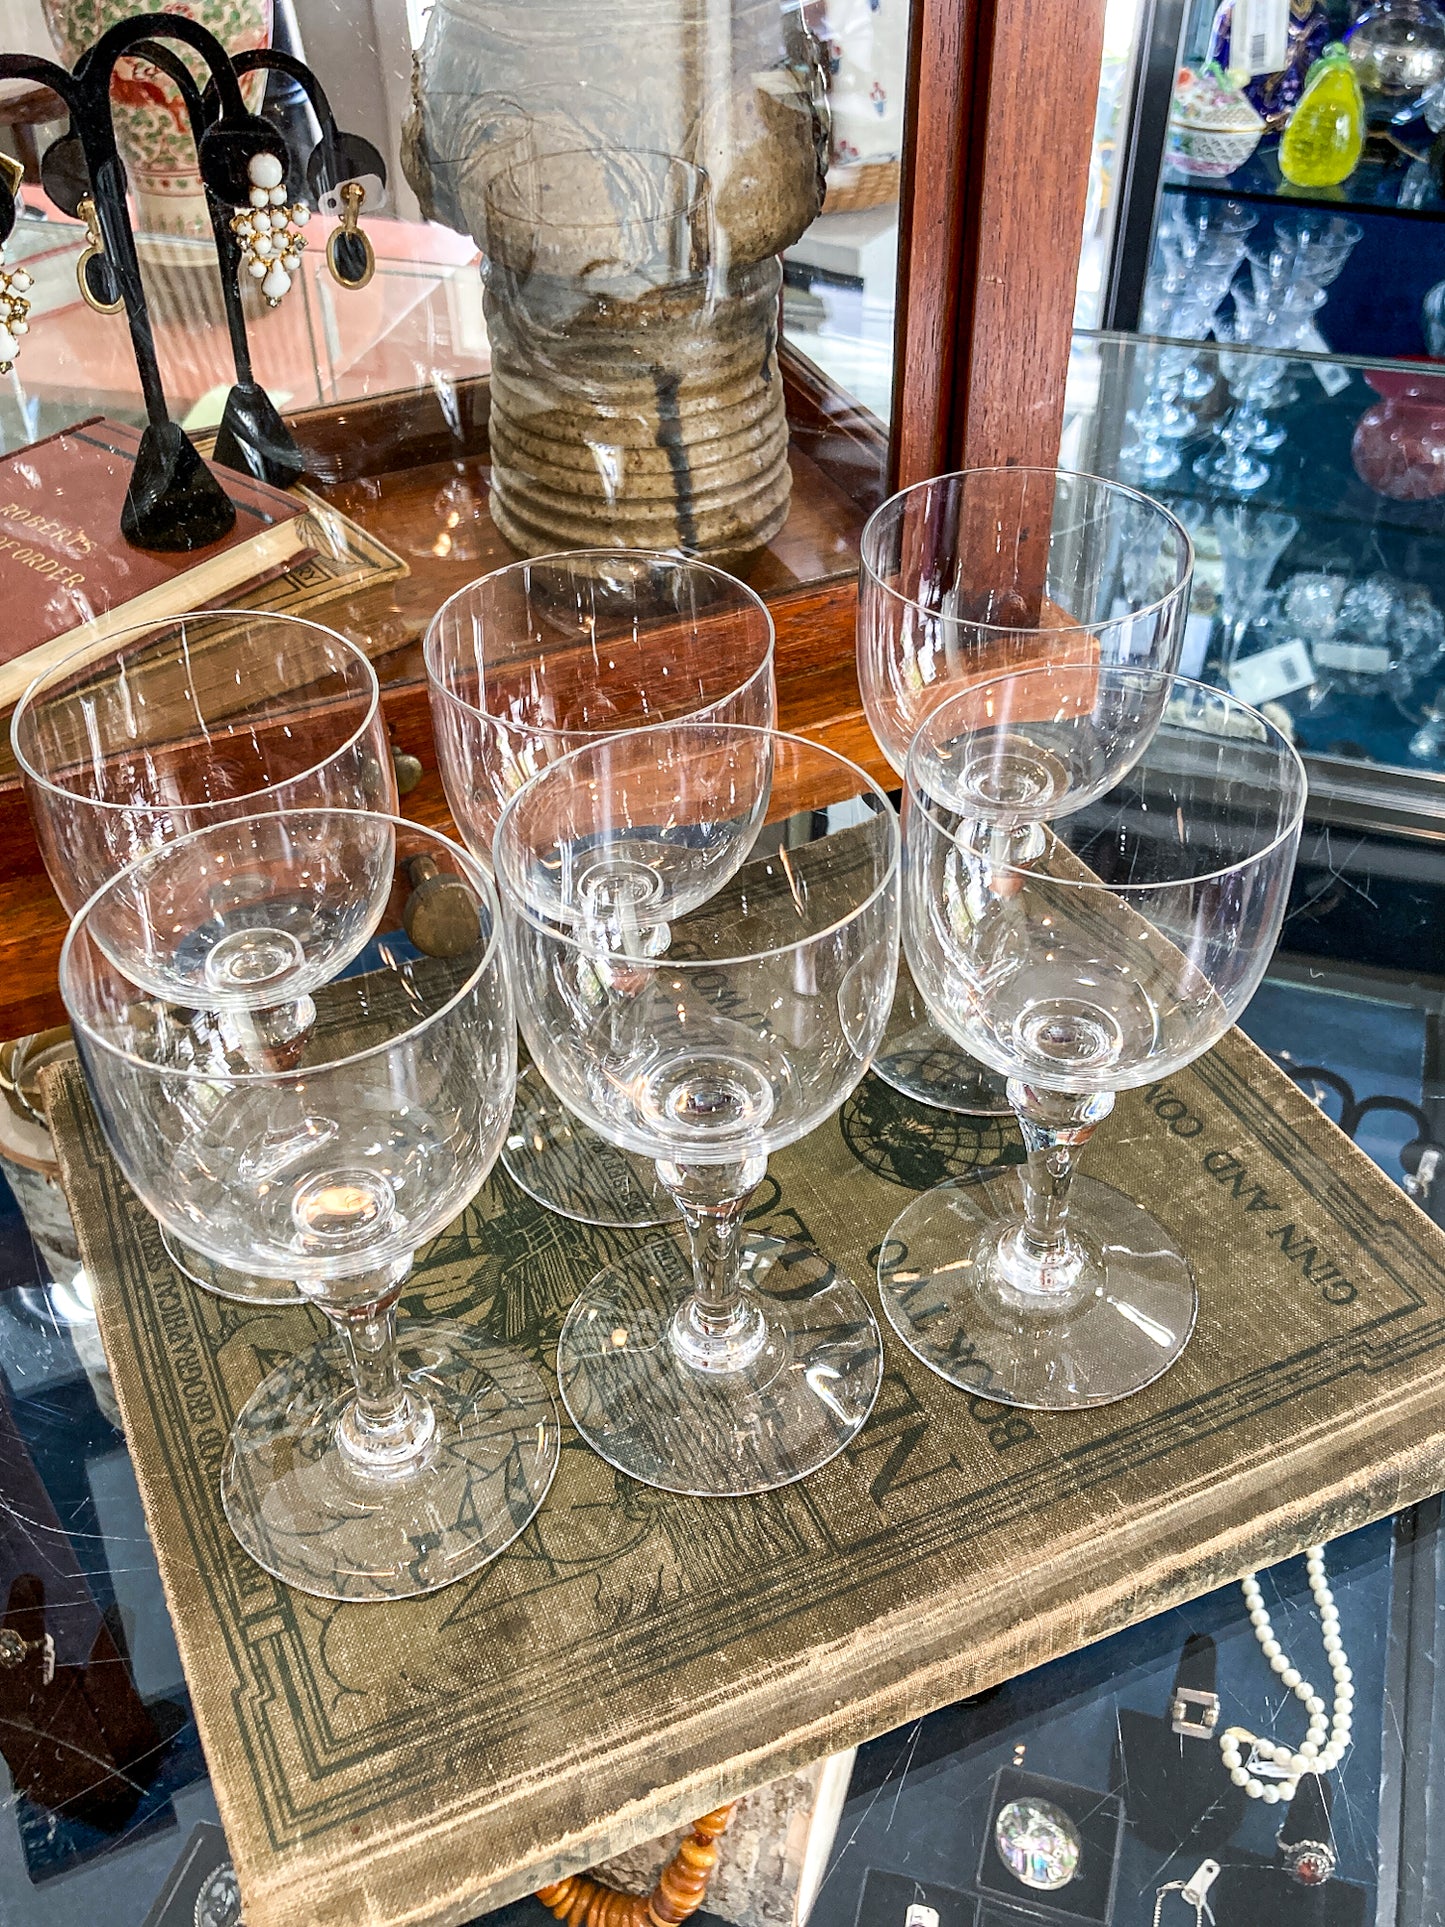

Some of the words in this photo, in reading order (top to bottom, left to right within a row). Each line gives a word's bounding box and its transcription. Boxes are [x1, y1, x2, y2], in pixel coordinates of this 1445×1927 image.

[12, 548, 86, 588] ORDER
[1204, 1149, 1281, 1212] AND
[135, 1207, 173, 1276] SERIES
[867, 1239, 949, 1328] TWO
[1266, 1224, 1359, 1308] GINN
[155, 1277, 213, 1423] GEOGRAPHICAL
[929, 1327, 1037, 1454] BOOK
